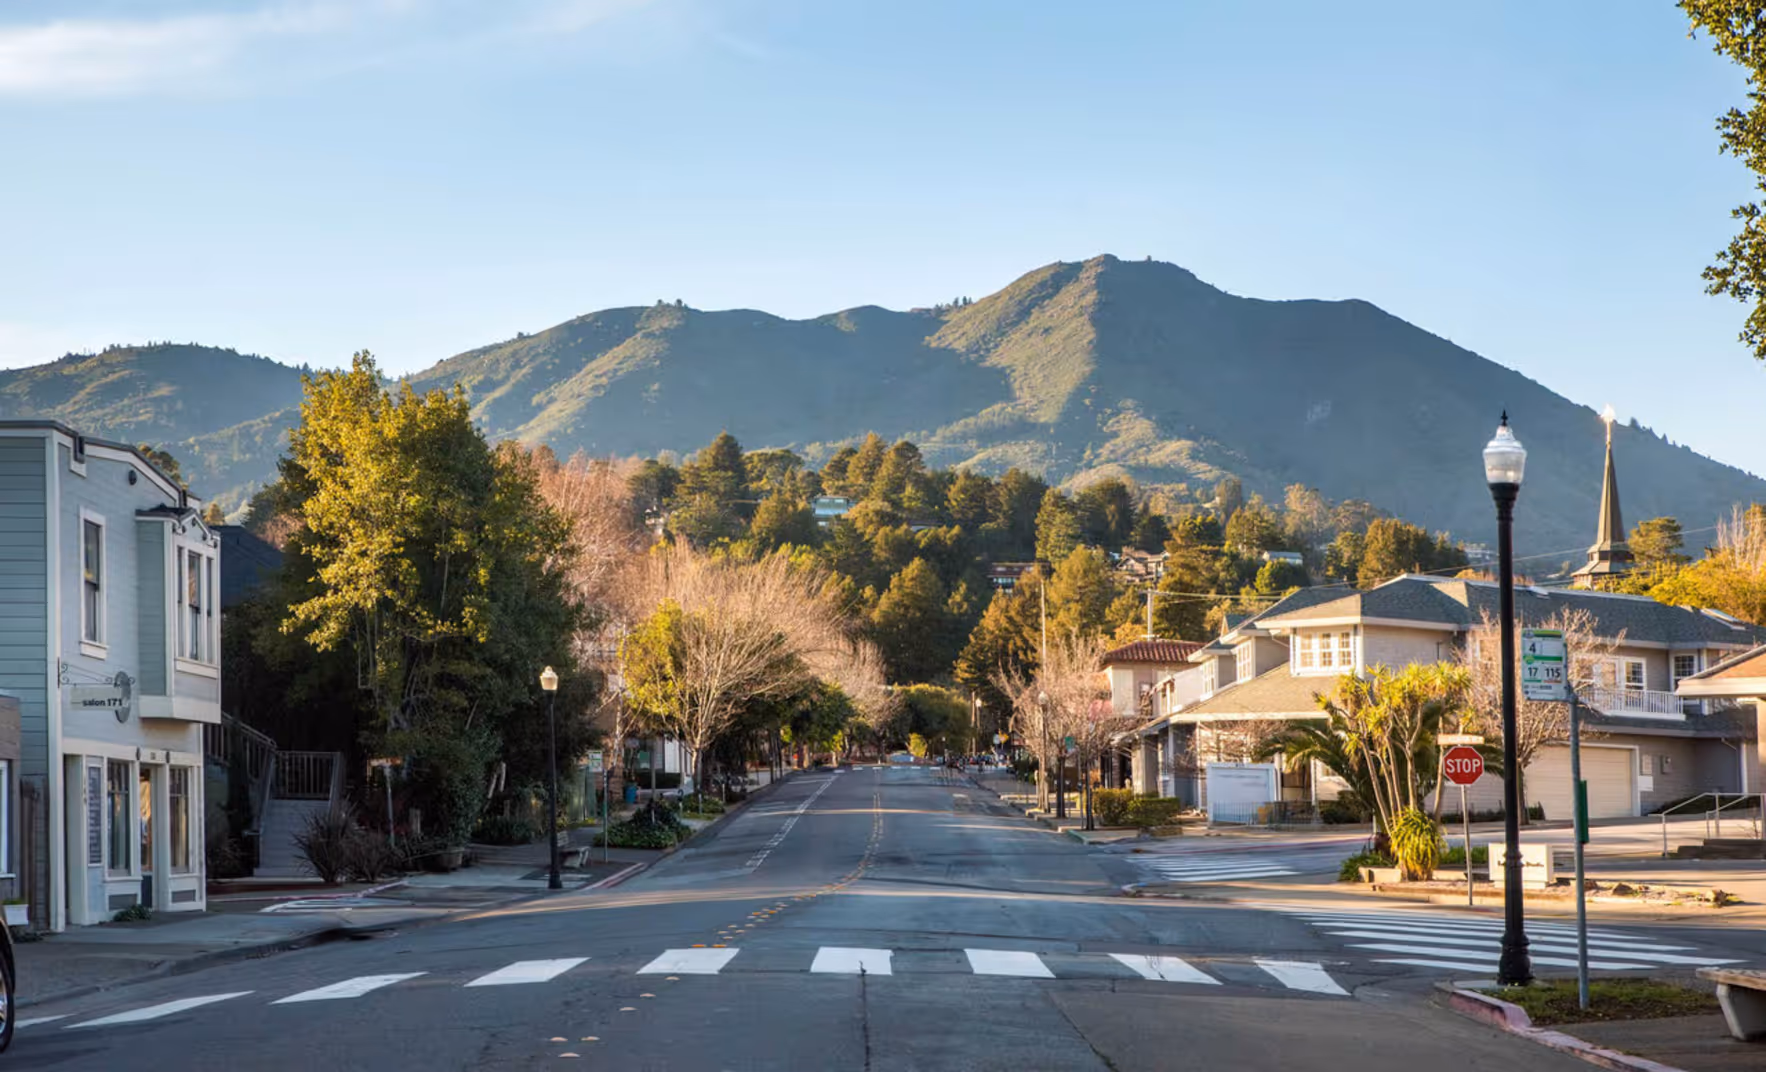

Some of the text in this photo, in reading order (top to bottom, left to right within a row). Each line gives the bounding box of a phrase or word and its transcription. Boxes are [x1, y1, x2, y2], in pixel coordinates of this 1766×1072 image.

[1529, 642, 1536, 654] 4
[1527, 667, 1561, 678] 17 115
[82, 698, 122, 707] salon 171
[1446, 758, 1481, 773] STOP
